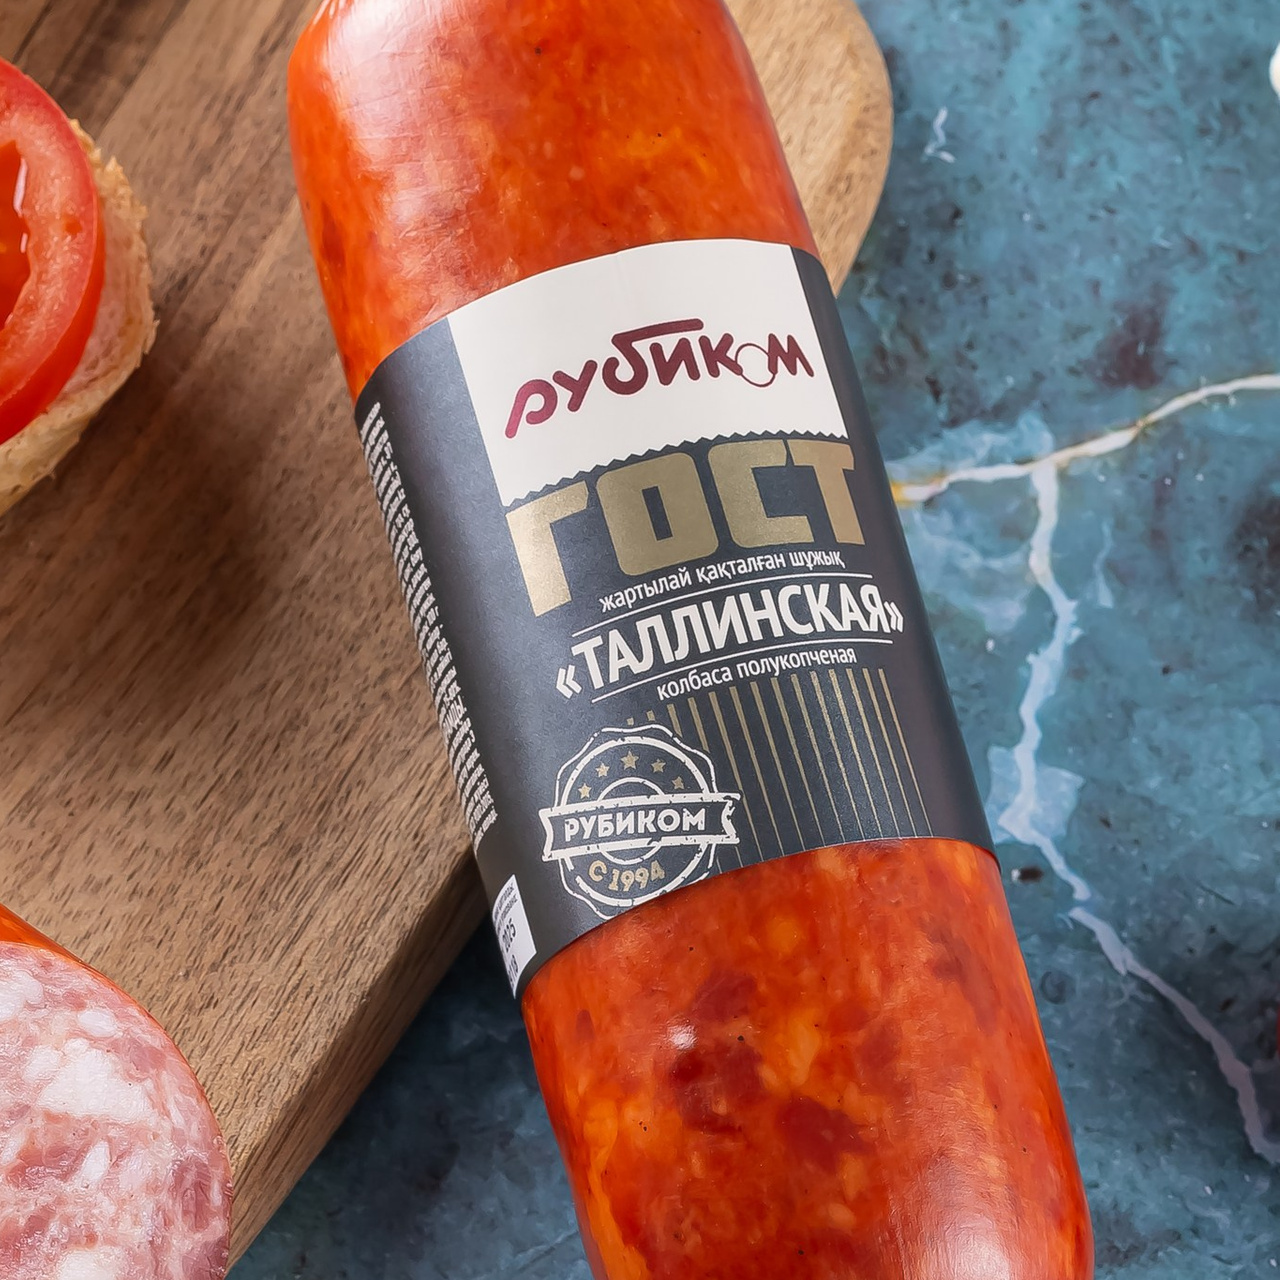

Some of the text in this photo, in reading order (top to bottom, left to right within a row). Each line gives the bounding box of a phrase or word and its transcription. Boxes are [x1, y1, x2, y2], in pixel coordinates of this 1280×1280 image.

[506, 439, 865, 617] ГОСТ
[599, 569, 691, 613] жартылай
[696, 552, 787, 585] қақталған
[556, 583, 904, 700] «ТАЛЛИНСКАЯ»
[657, 647, 858, 701] колбаса полукопченая
[564, 808, 706, 842] РУБИКОМ
[588, 859, 666, 892] С 1994
